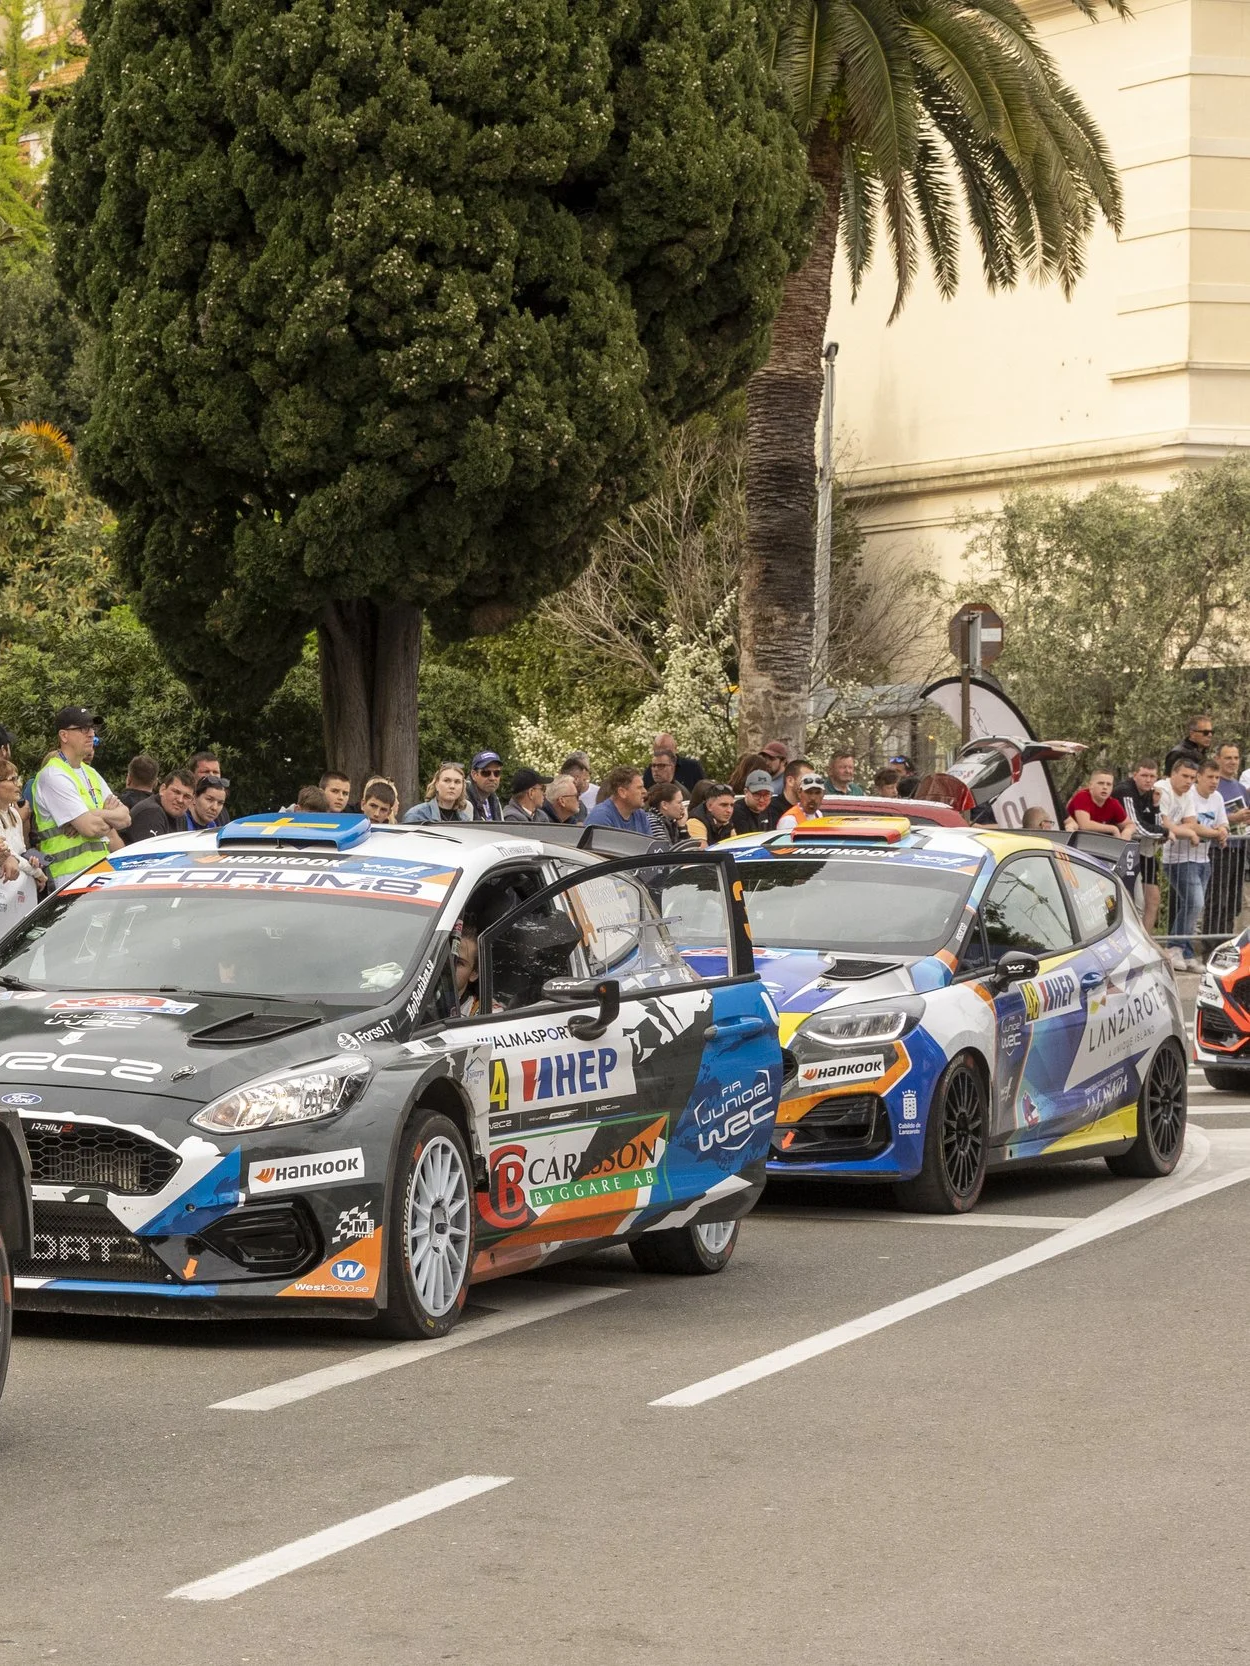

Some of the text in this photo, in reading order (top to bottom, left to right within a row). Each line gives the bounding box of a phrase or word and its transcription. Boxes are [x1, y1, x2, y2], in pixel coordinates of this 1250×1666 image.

[136, 870, 423, 896] FORUM8
[355, 1019, 394, 1044] Forss IT
[553, 1047, 618, 1096] HEP
[721, 1080, 742, 1098] FIA
[700, 1081, 768, 1125] JUNIOR
[31, 1122, 74, 1134] Rally2
[699, 1096, 775, 1152] WRC
[534, 1171, 655, 1205] BYGGARE AB
[354, 1221, 368, 1233] M
[336, 1263, 364, 1279] W
